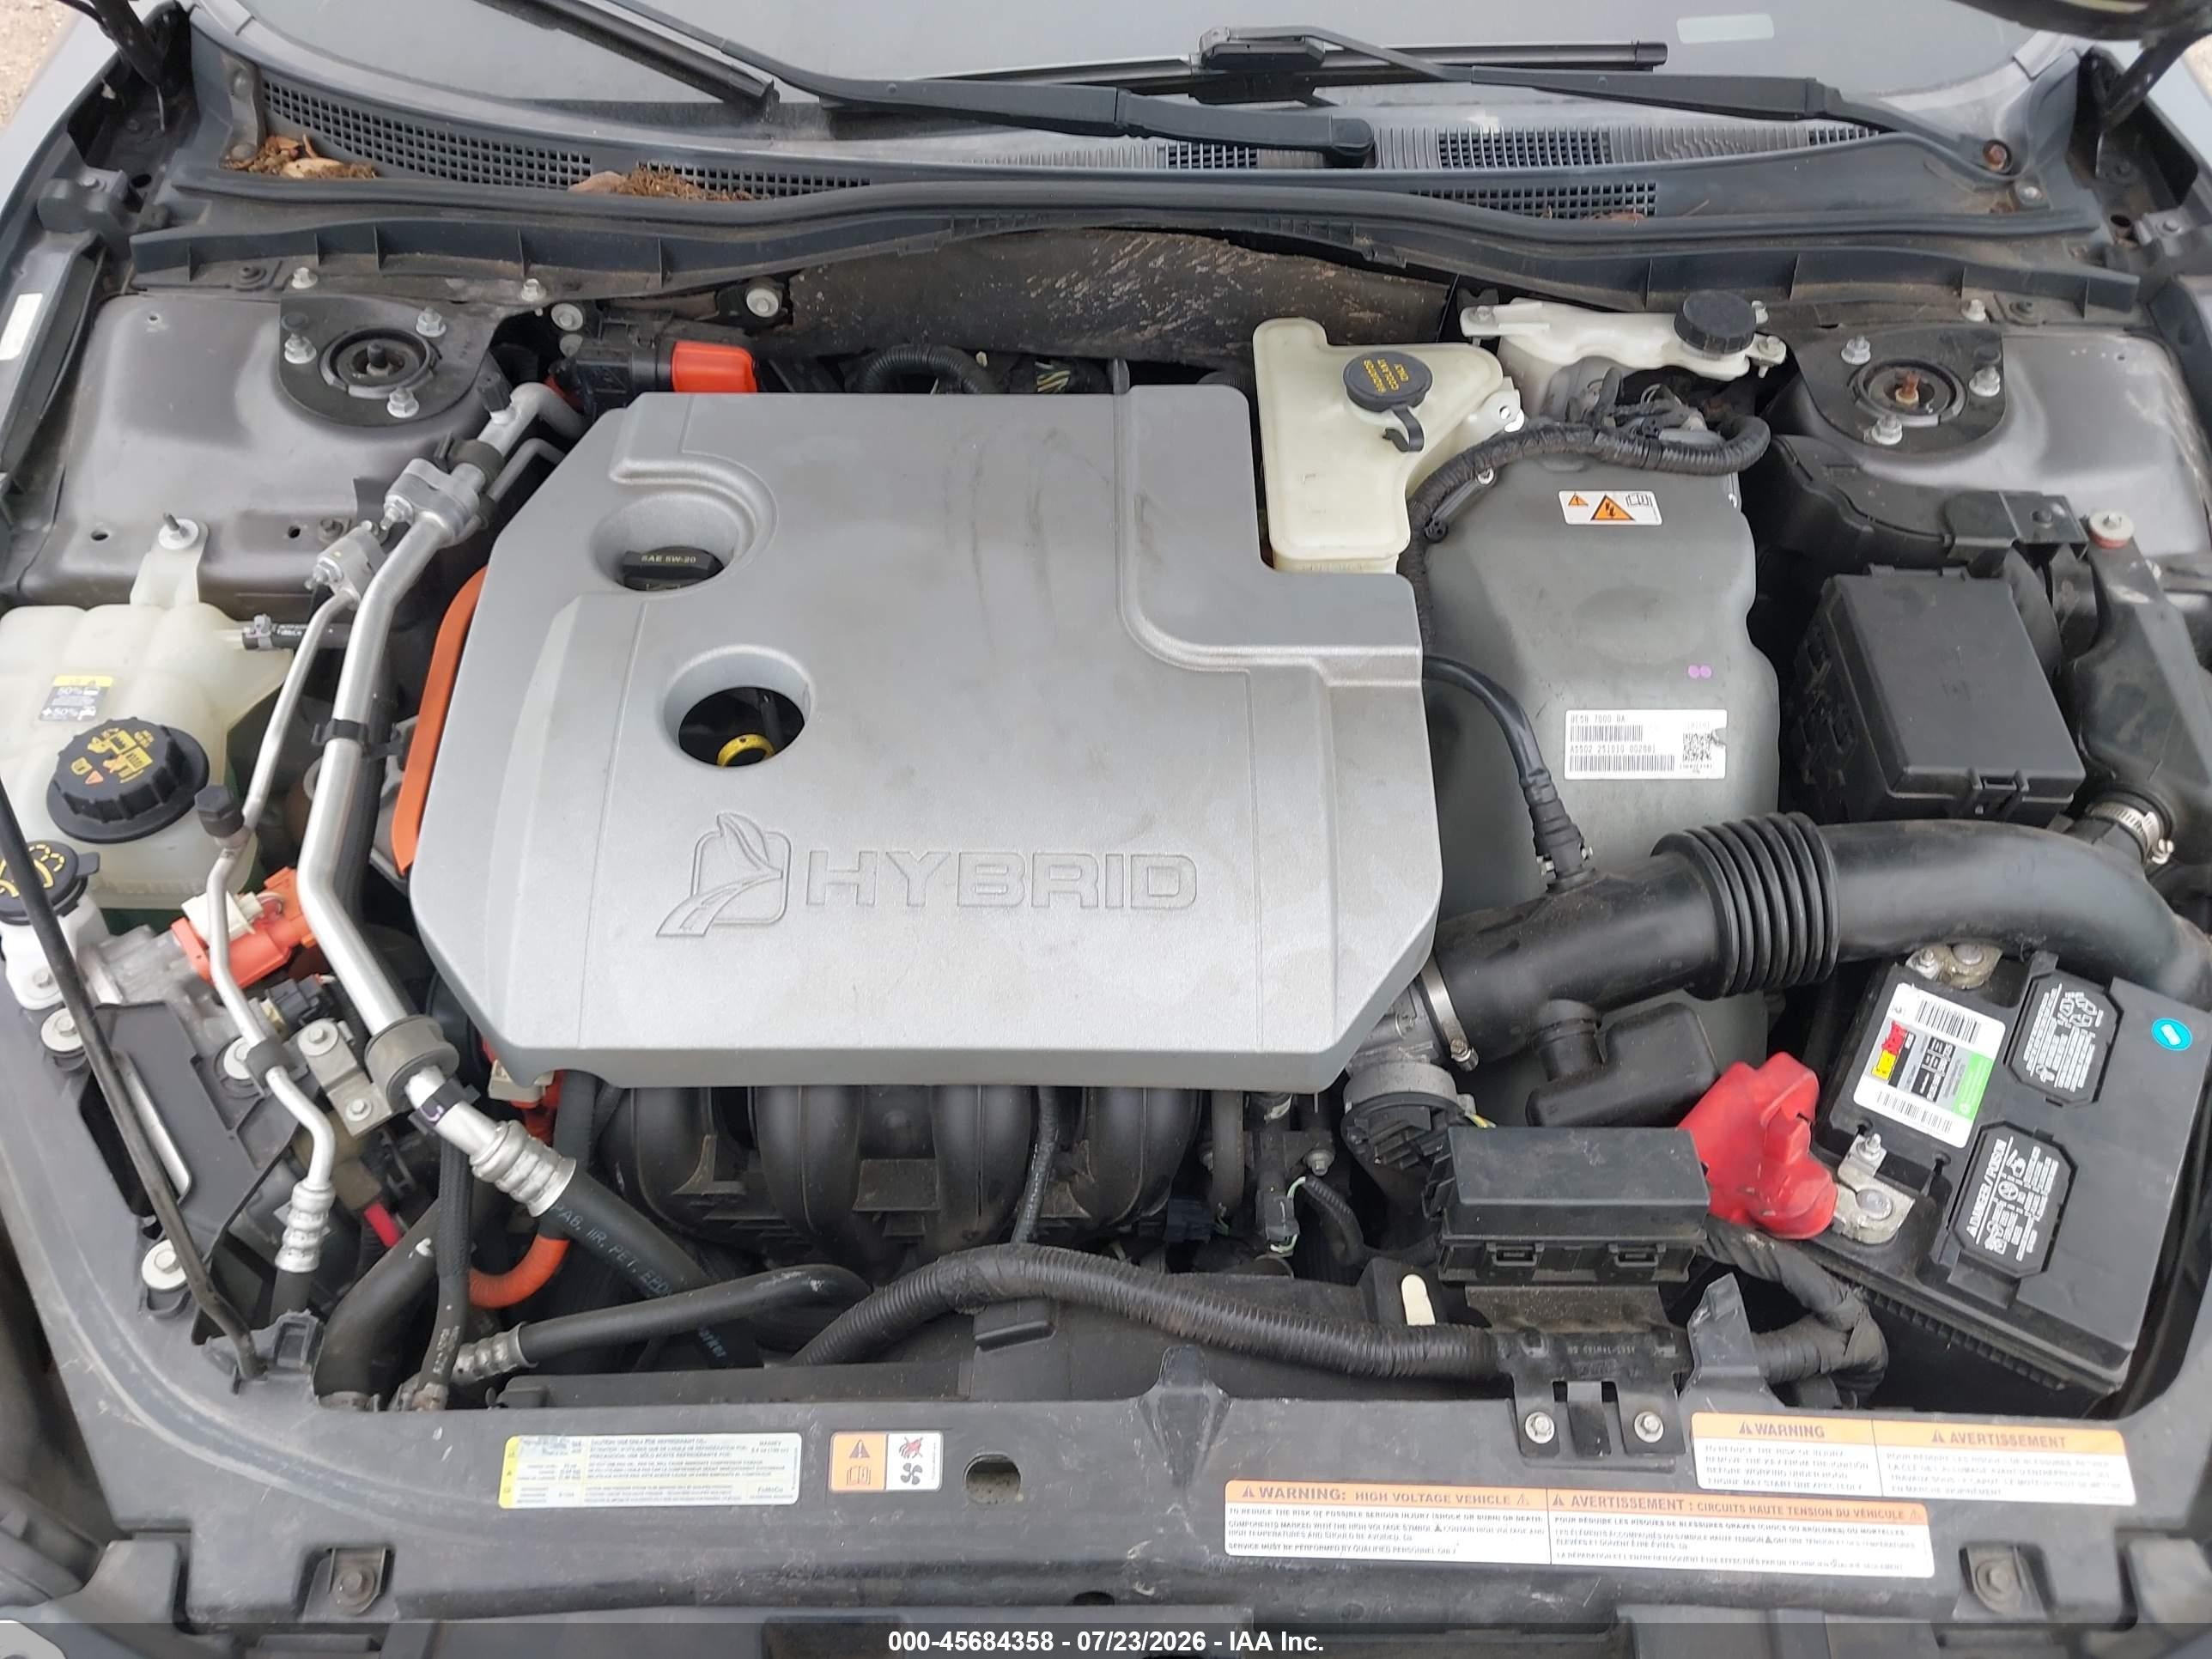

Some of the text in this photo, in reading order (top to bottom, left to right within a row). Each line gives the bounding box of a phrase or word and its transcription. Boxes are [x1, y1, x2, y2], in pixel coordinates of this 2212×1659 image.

[805, 848, 1198, 908] HYBRID
[1755, 1424, 1825, 1437] WARNING
[1950, 1431, 2067, 1449] AVERTISSEMENT
[1260, 1487, 1510, 1505] WARNING: HIGH VOLTAGE VEHICLE
[1571, 1496, 1684, 1510] AVERTISSEMENT
[1697, 1503, 1745, 1513] CIRCUITS
[1749, 1504, 1784, 1514] HAUTE
[1788, 1505, 1832, 1516] TENSION
[1836, 1507, 1850, 1516] DU
